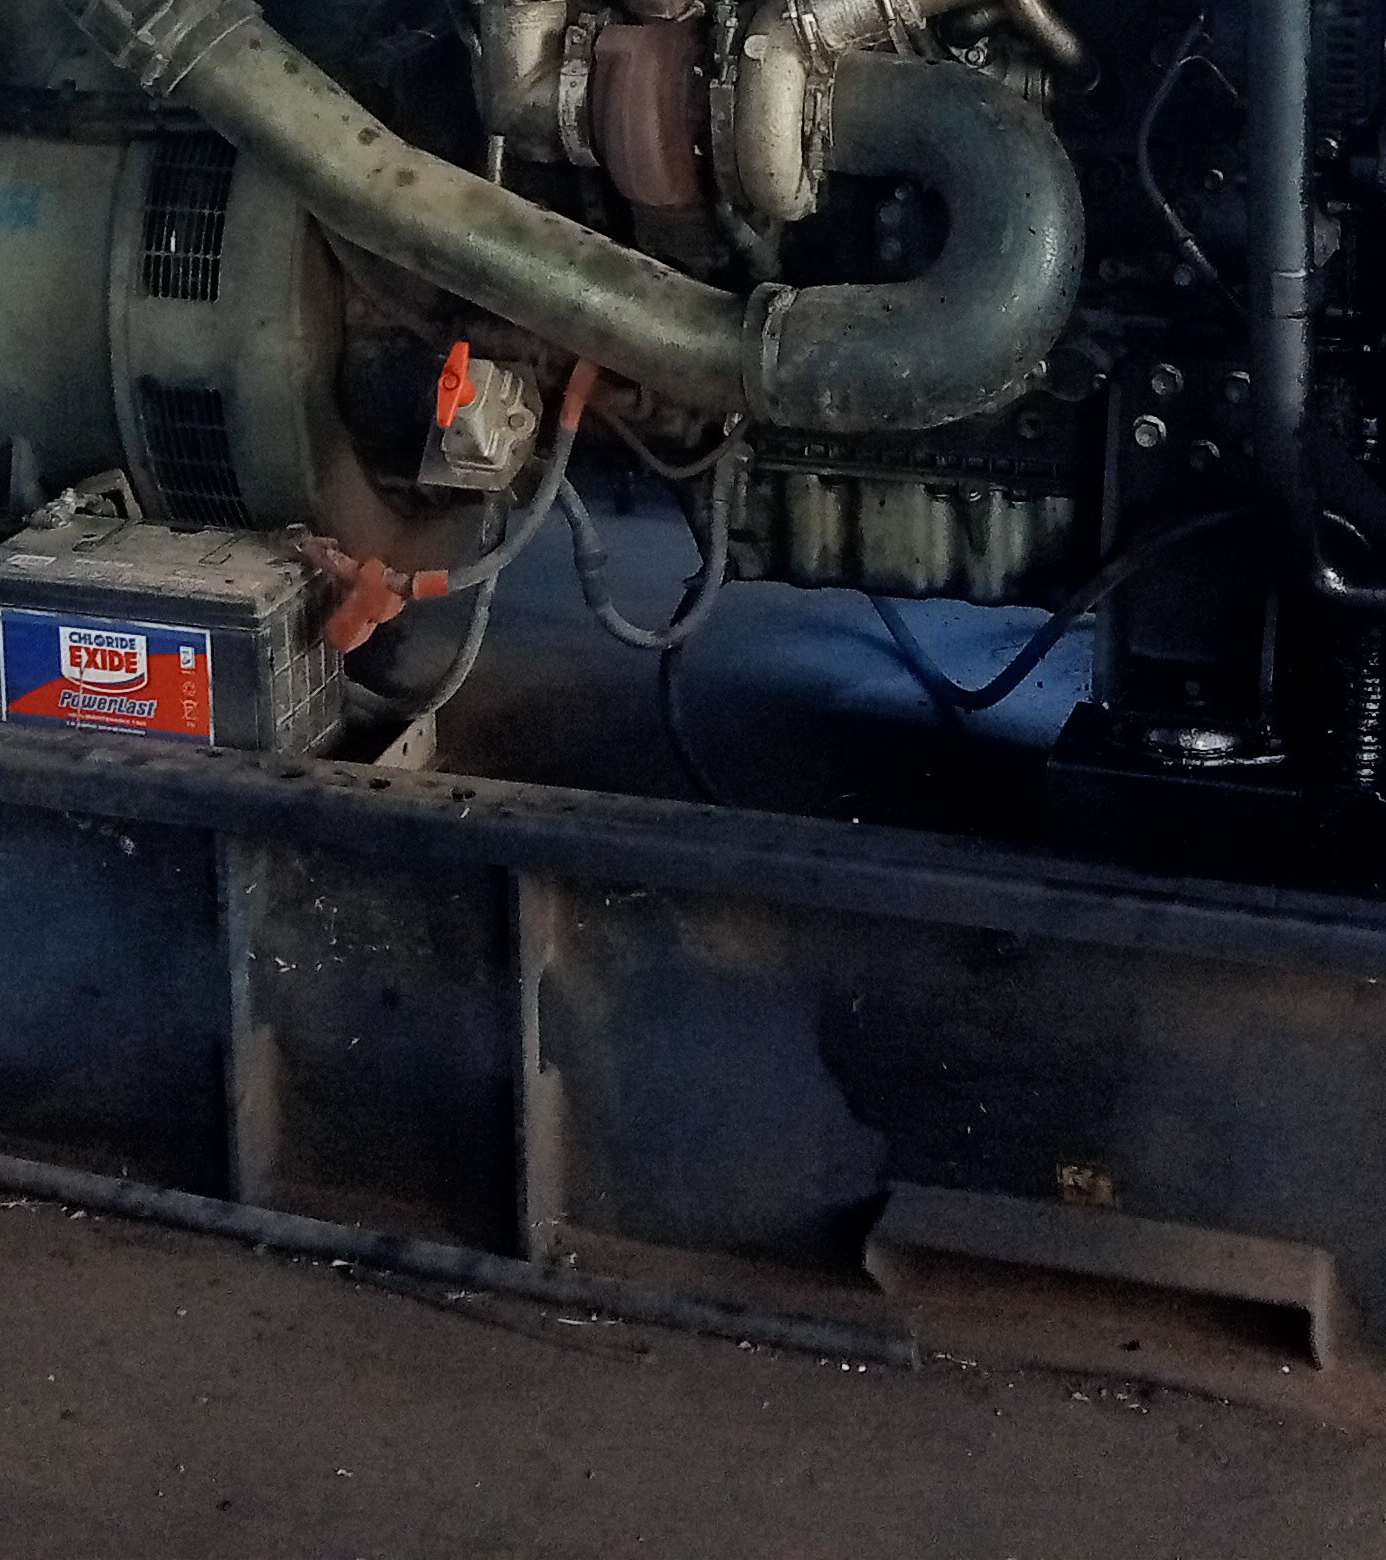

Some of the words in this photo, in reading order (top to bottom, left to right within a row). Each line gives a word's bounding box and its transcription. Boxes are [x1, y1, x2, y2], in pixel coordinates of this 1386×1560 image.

[69, 631, 136, 650] CHLORIDE
[69, 645, 138, 674] EXIDE
[59, 690, 158, 719] PowerLast
